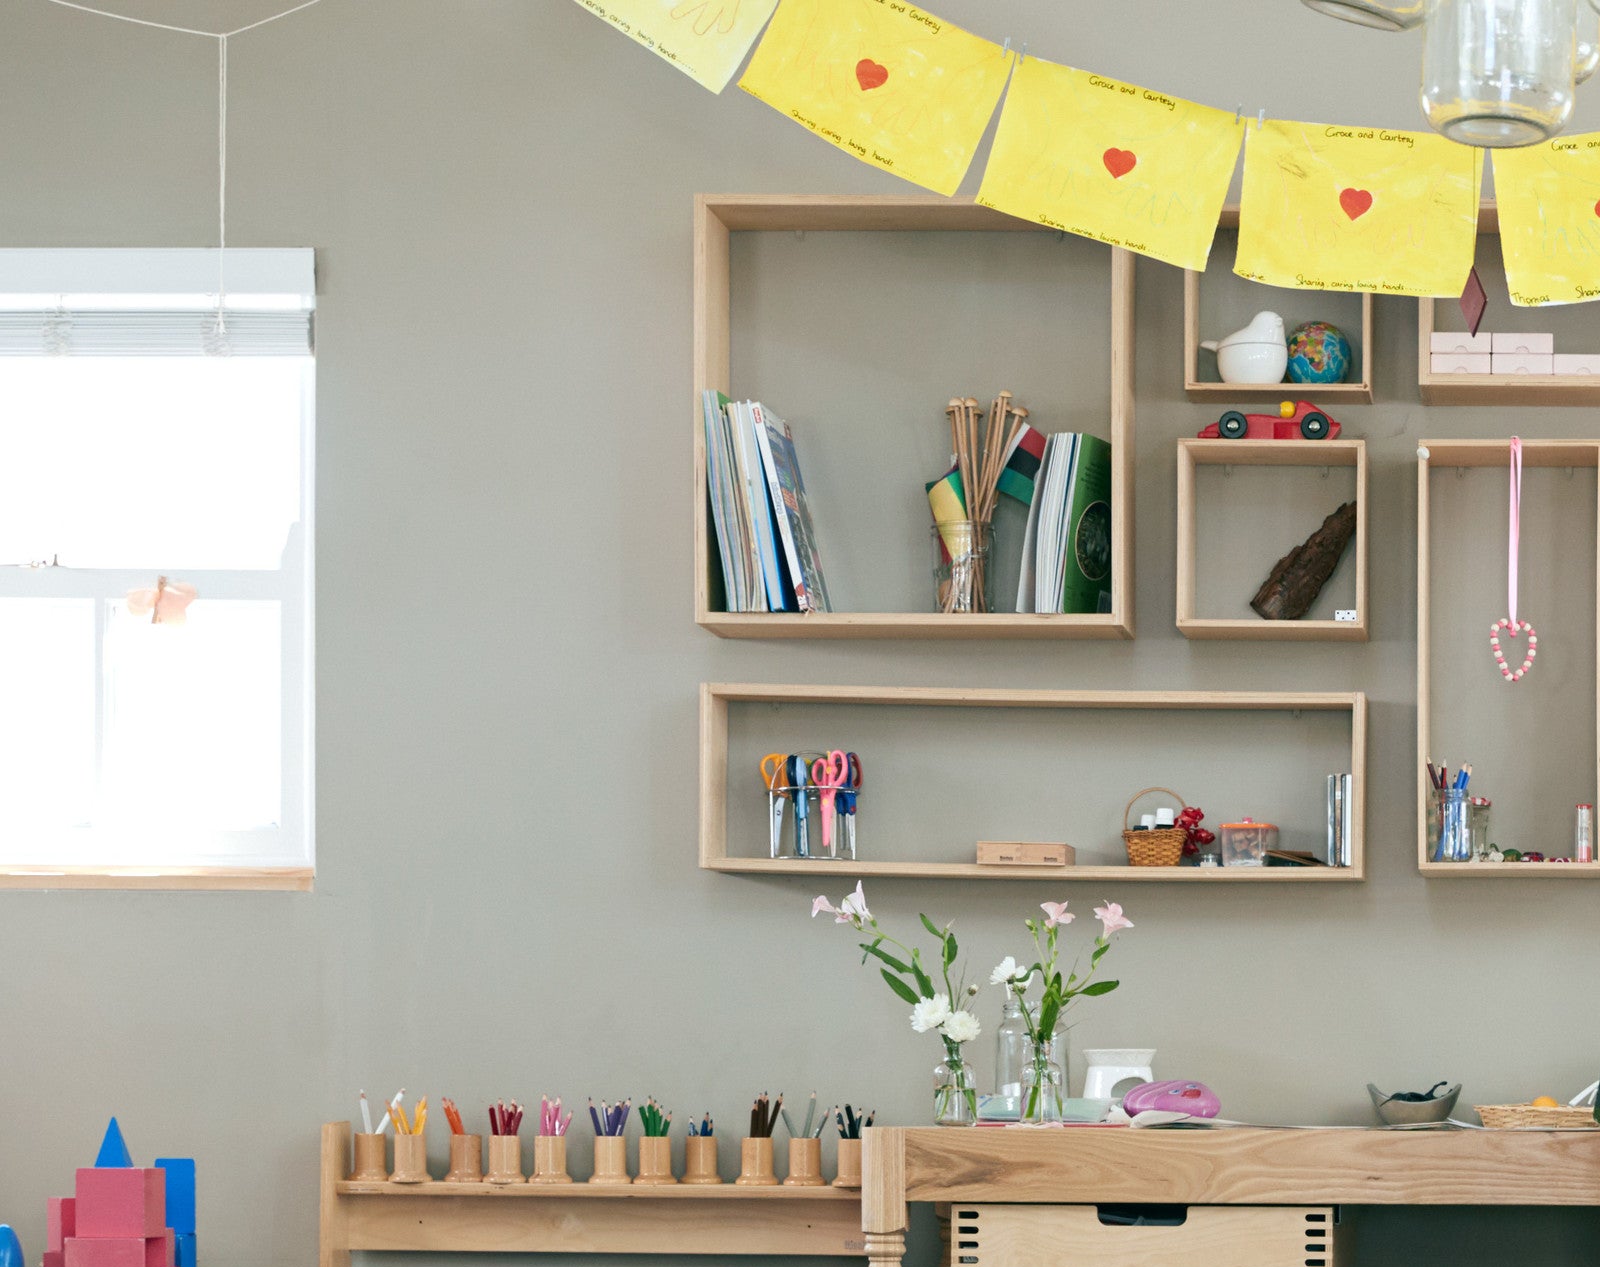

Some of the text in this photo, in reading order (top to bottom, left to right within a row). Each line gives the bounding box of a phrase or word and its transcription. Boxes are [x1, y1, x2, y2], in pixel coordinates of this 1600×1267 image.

[890, 3, 941, 35] and Courtesy
[1088, 75, 1176, 112] Grace and Courtesy
[1324, 126, 1415, 148] Grace and Courtesy
[1551, 139, 1579, 152] Grace
[1356, 276, 1378, 291] loving
[1512, 292, 1551, 306] Thomas
